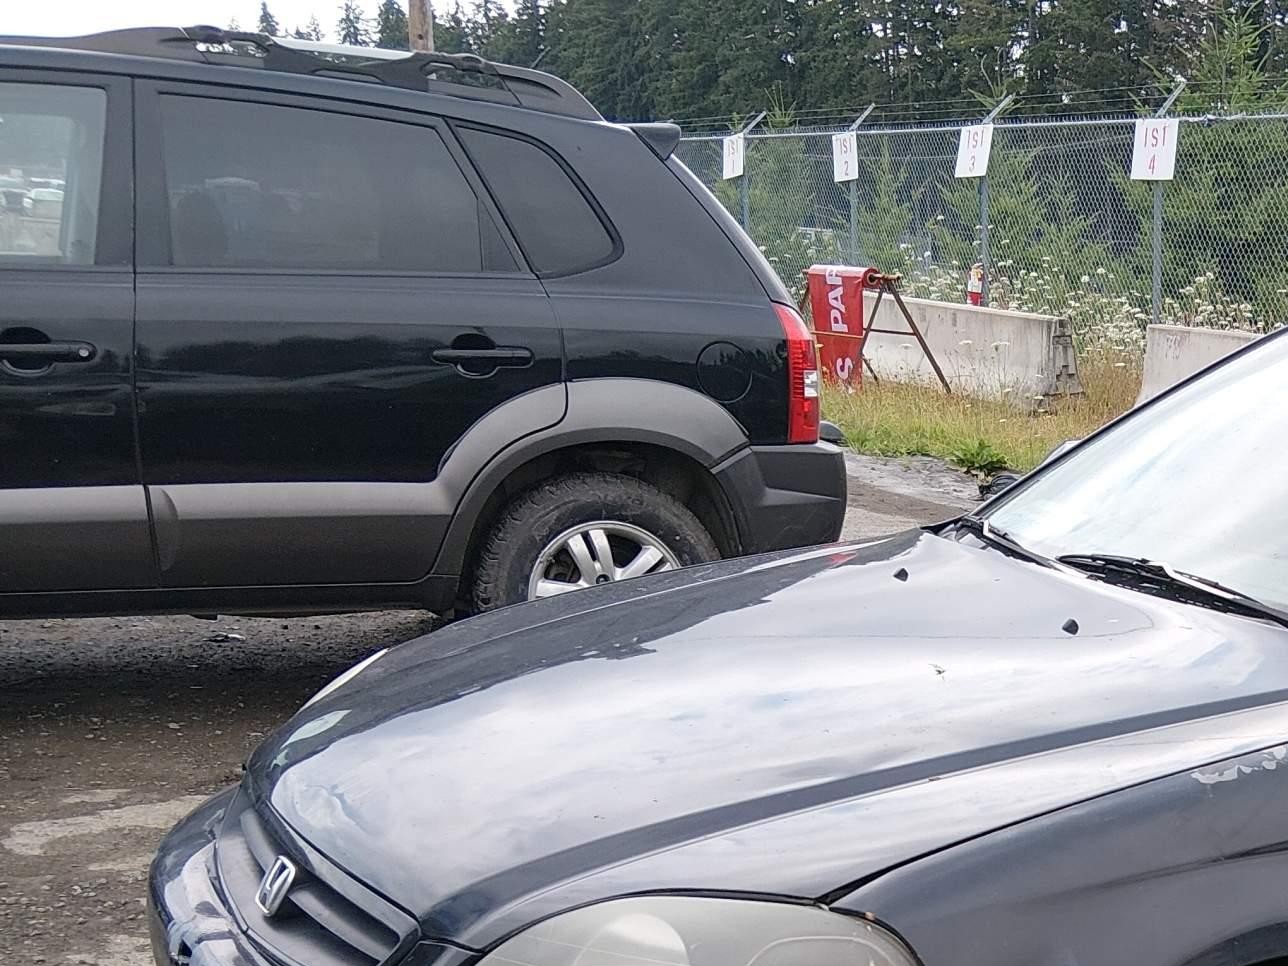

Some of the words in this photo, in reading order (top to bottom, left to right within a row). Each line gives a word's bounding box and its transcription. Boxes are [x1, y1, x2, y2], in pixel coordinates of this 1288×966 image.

[844, 161, 849, 176] 2
[968, 155, 976, 173] 3
[1148, 154, 1156, 176] 4
